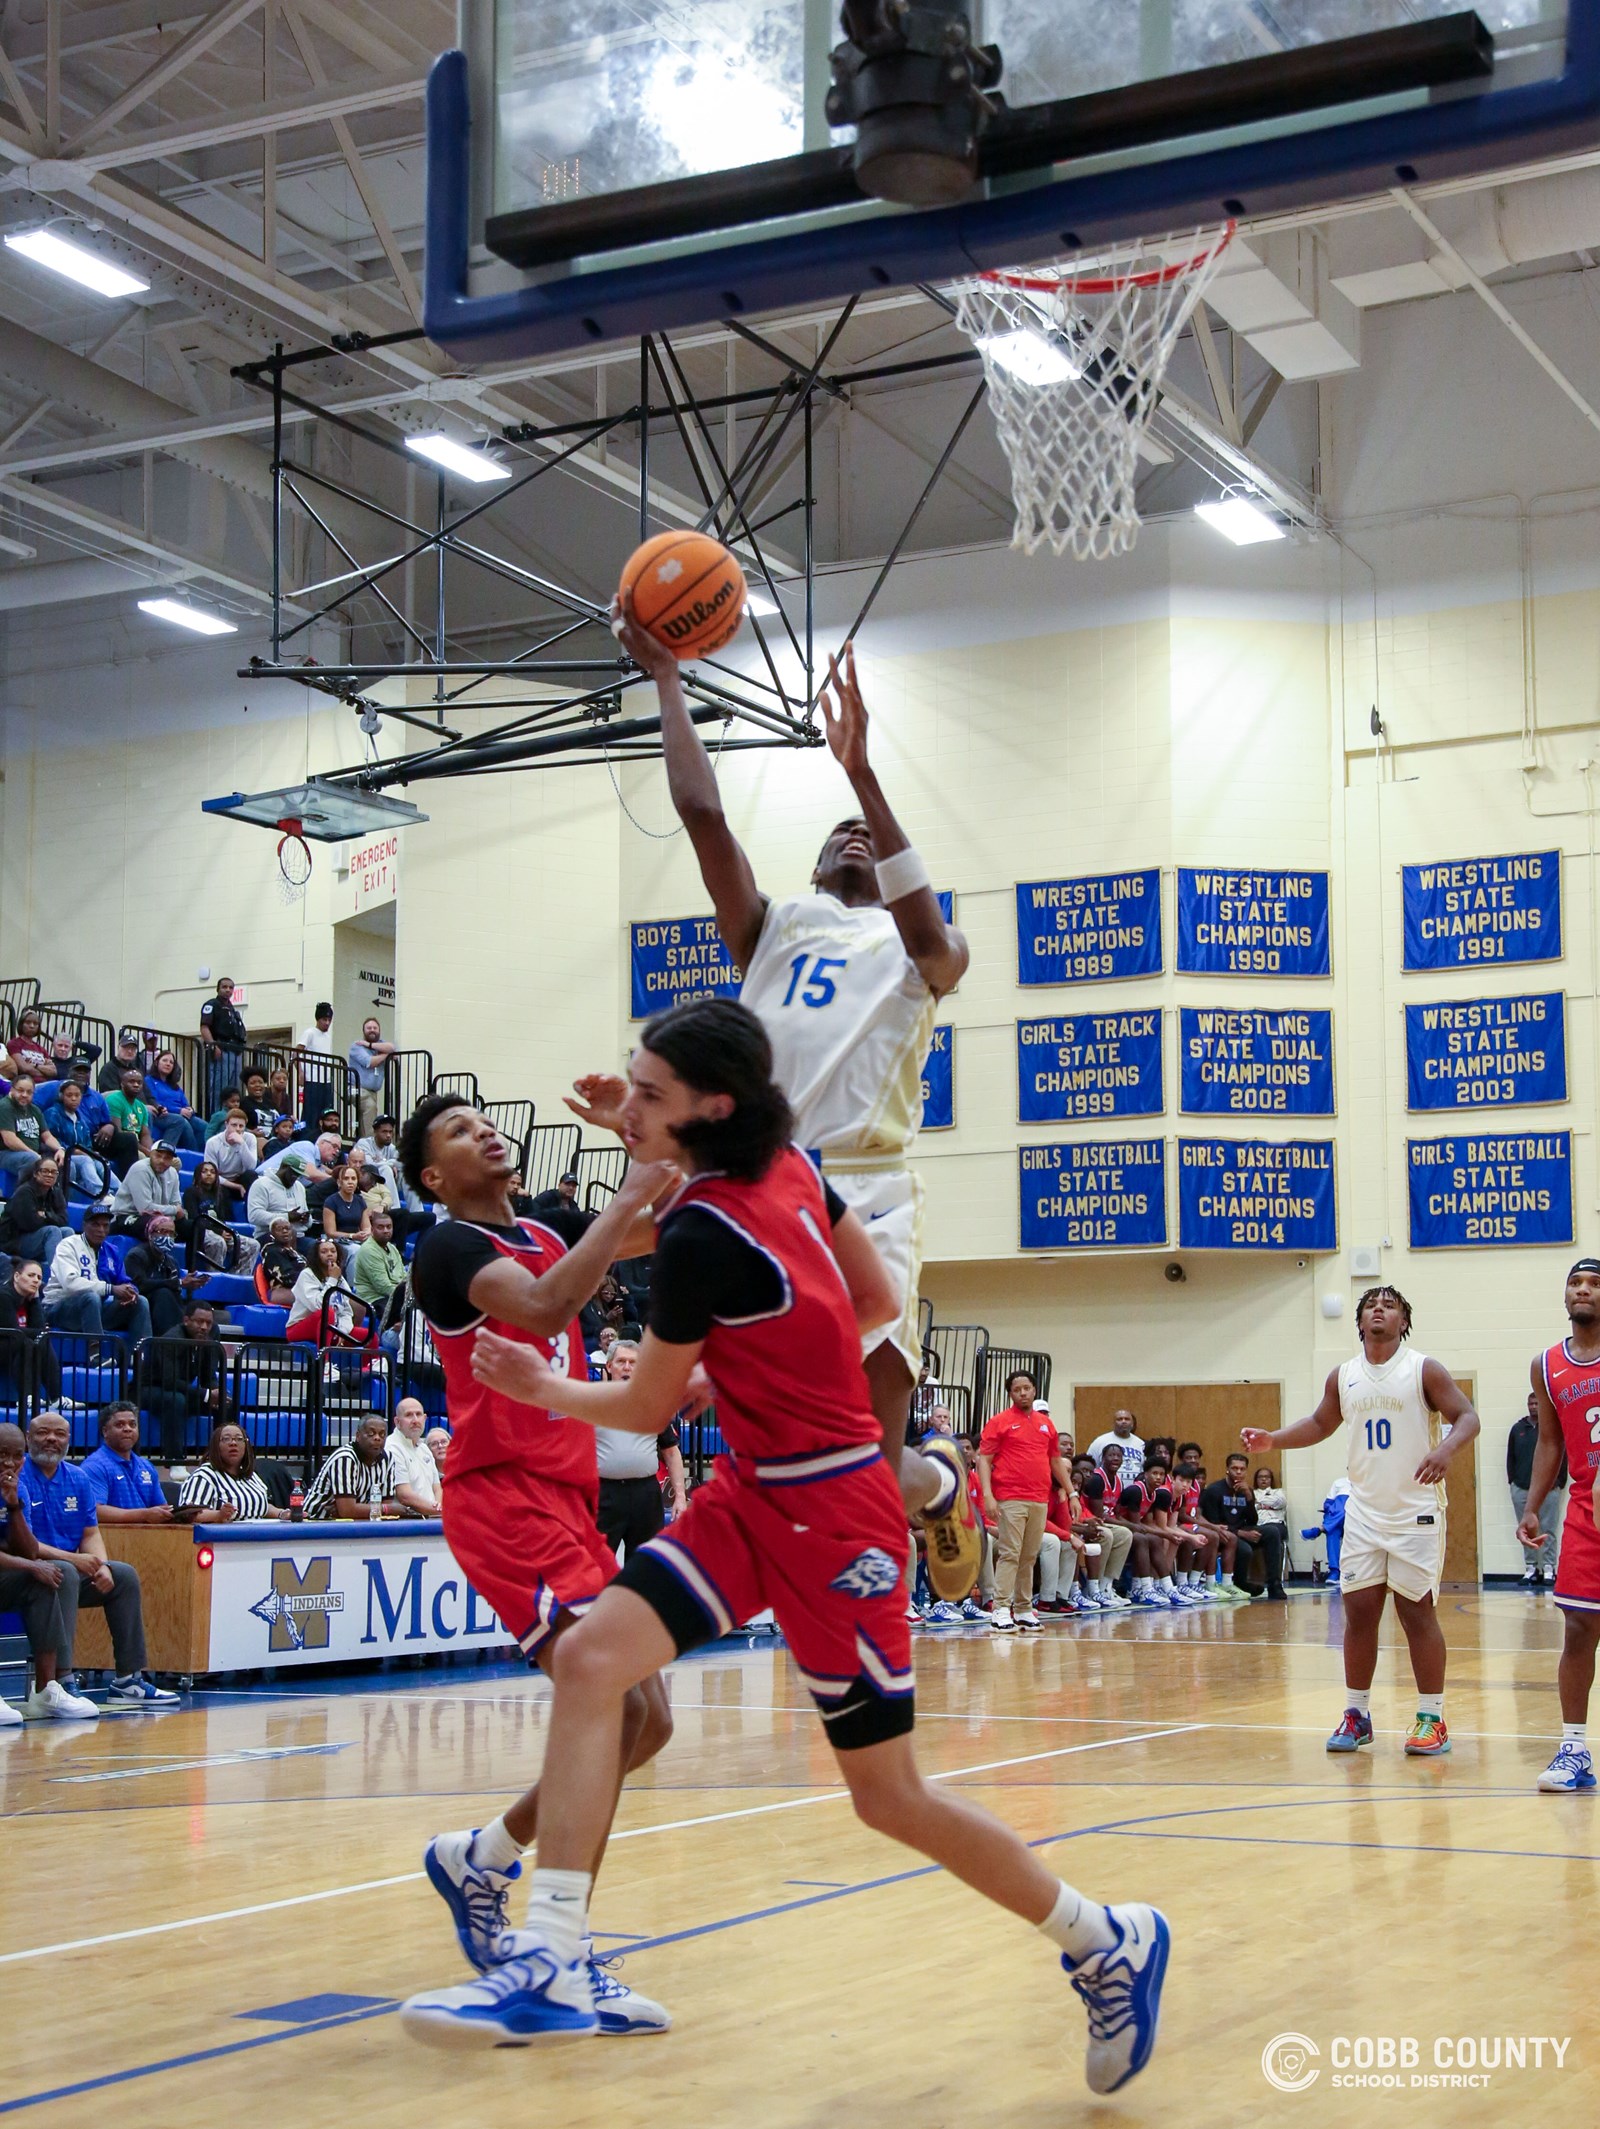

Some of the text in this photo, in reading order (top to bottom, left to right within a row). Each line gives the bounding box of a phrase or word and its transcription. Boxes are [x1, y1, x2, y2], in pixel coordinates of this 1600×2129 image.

[662, 579, 735, 640] Wilson
[364, 866, 388, 893] EXIT
[1195, 875, 1313, 898] WRESTLING
[1419, 858, 1542, 891] WRESTLING
[1032, 876, 1145, 908] WRESTLING
[1445, 885, 1515, 912] STATE
[1056, 904, 1120, 931] STATE
[1220, 901, 1287, 922] STATE
[1421, 908, 1541, 939] CHAMPIONS
[637, 921, 721, 948] BOYS TR
[1034, 926, 1144, 956] CHAMPIONS
[1196, 925, 1312, 946] CHAMPIONS
[666, 943, 721, 967] STATE
[1458, 937, 1505, 960] 1991
[1065, 954, 1113, 978] 1989
[1229, 951, 1280, 971] 1990
[646, 965, 743, 991] CHAMPIONS
[782, 953, 848, 1009] 15
[1197, 1014, 1310, 1036] WRESTLING
[1422, 1000, 1546, 1030] WRESTLING
[1021, 1016, 1155, 1045] GIRLS TRACK
[1448, 1028, 1519, 1053] STATE
[1058, 1043, 1120, 1067] STATE
[1189, 1038, 1322, 1060] STATE DUAL
[1200, 1064, 1310, 1085] CHAMPIONS
[1424, 1051, 1545, 1080] CHAMPIONS
[1035, 1065, 1140, 1093] CHAMPIONS
[1456, 1079, 1515, 1102] 2003
[1066, 1093, 1115, 1115] 1999
[1230, 1088, 1287, 1109] 2002
[1022, 1144, 1161, 1170] GIRLS BASKETBALL
[1183, 1146, 1329, 1169] GIRLS BASKETBALL
[1412, 1139, 1565, 1165] GIRLS BASKETBALL
[1059, 1171, 1124, 1193] STATE
[1222, 1172, 1291, 1193] STATE
[1453, 1165, 1524, 1189] STATE
[1037, 1194, 1148, 1218] CHAMPIONS
[1199, 1196, 1315, 1219] CHAMPIONS
[1429, 1190, 1550, 1215] CHAMPIONS
[1068, 1220, 1117, 1241] 2012
[1231, 1222, 1285, 1243] 2014
[1466, 1217, 1517, 1238] 2015
[1365, 1418, 1391, 1450] 10
[293, 1595, 342, 1610] INDIANS
[360, 1556, 512, 1645] McE
